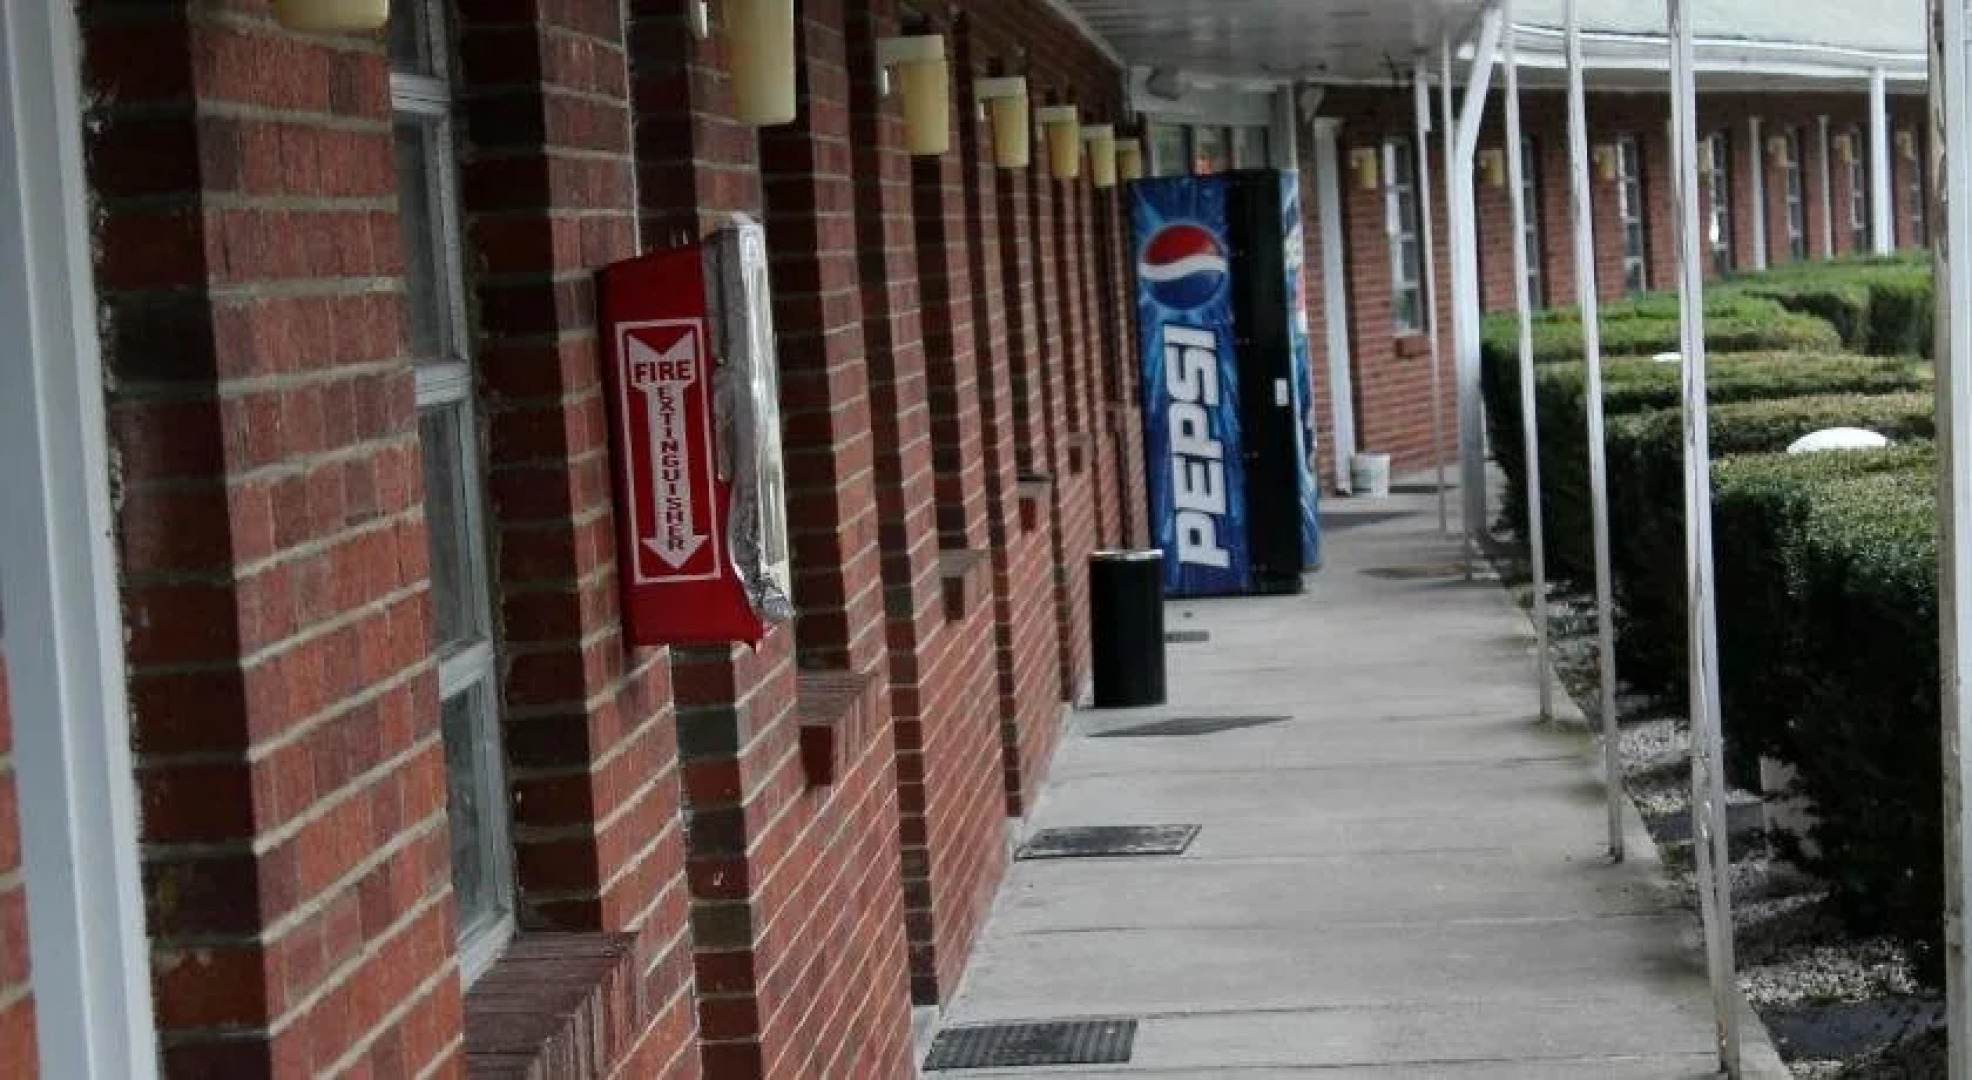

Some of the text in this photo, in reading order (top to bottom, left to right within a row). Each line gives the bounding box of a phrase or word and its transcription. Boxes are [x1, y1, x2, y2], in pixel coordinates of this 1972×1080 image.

[634, 360, 692, 383] FIRE
[1164, 325, 1230, 568] PEPSI
[658, 386, 685, 551] EXTINGUISHER
